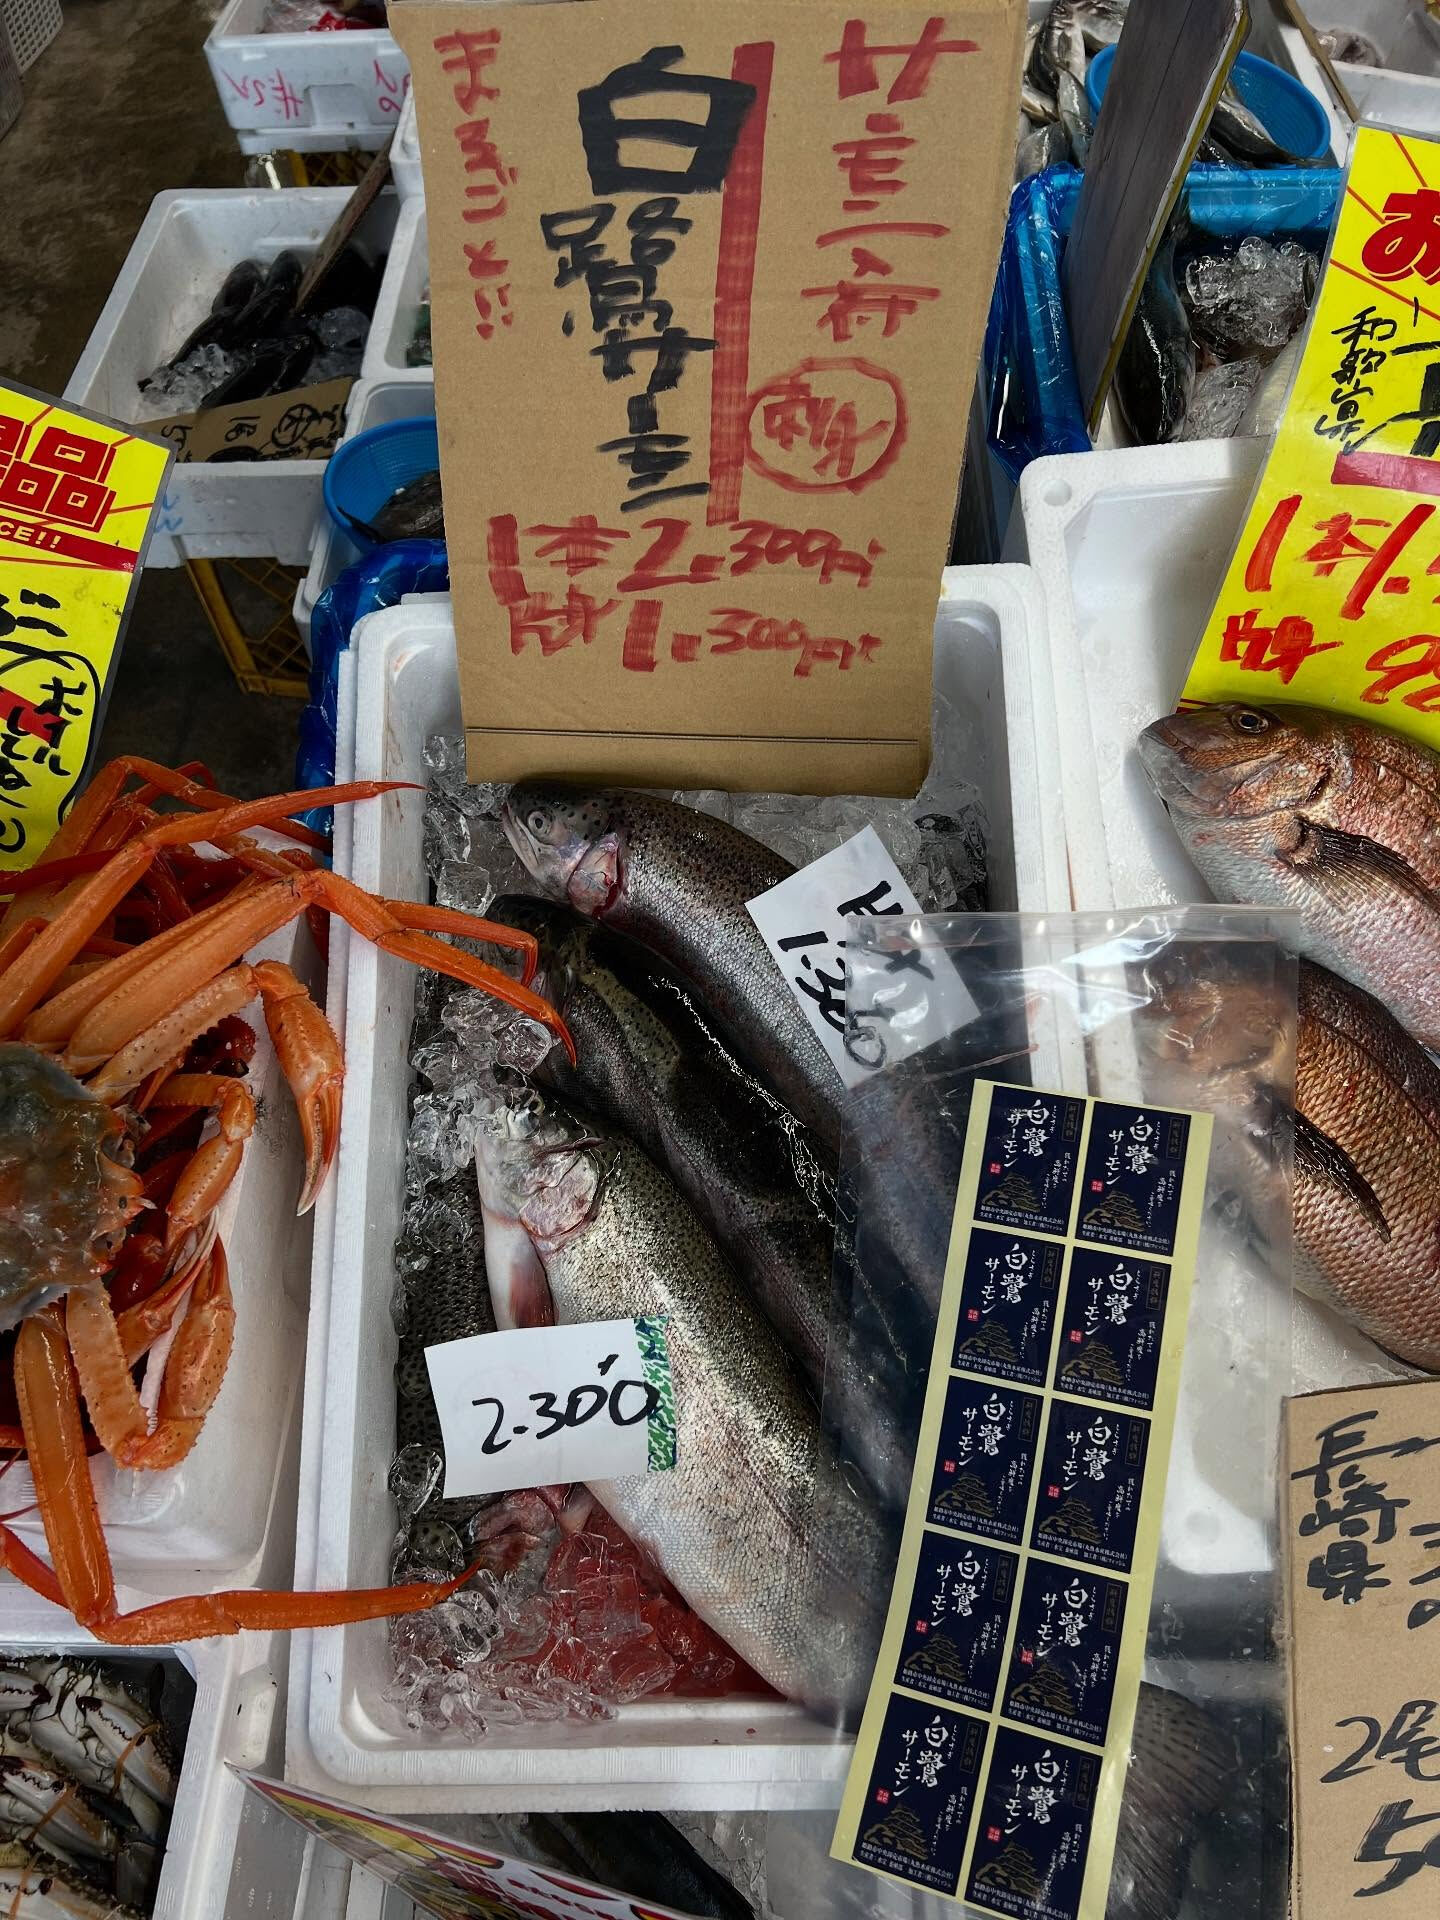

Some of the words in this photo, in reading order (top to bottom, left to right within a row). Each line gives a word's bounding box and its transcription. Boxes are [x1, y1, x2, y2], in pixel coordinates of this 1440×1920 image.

[1003, 1113, 1023, 1167] サーモン
[1021, 1098, 1050, 1156] 白鷺
[1105, 1129, 1125, 1184] サーモン
[1124, 1114, 1154, 1174] 白鷺
[981, 1257, 1001, 1313] サーモン
[999, 1242, 1029, 1303] 白鷺
[1103, 1262, 1134, 1324] 白鷺
[1084, 1277, 1104, 1335] サーモン
[958, 1407, 979, 1465] サーモン
[977, 1392, 1007, 1455] 白鷺
[1082, 1415, 1113, 1480] 白鷺
[1062, 1430, 1083, 1490] サーモン
[930, 1564, 953, 1626] サーモン
[950, 1549, 982, 1616] 白鷺
[1057, 1577, 1089, 1646] 白鷺
[1036, 1592, 1059, 1656] サーモン
[892, 1729, 919, 1796] サーモン
[915, 1714, 949, 1787] 白鷺
[1004, 1762, 1029, 1832] サーモン
[1027, 1748, 1061, 1822] 白鷺
